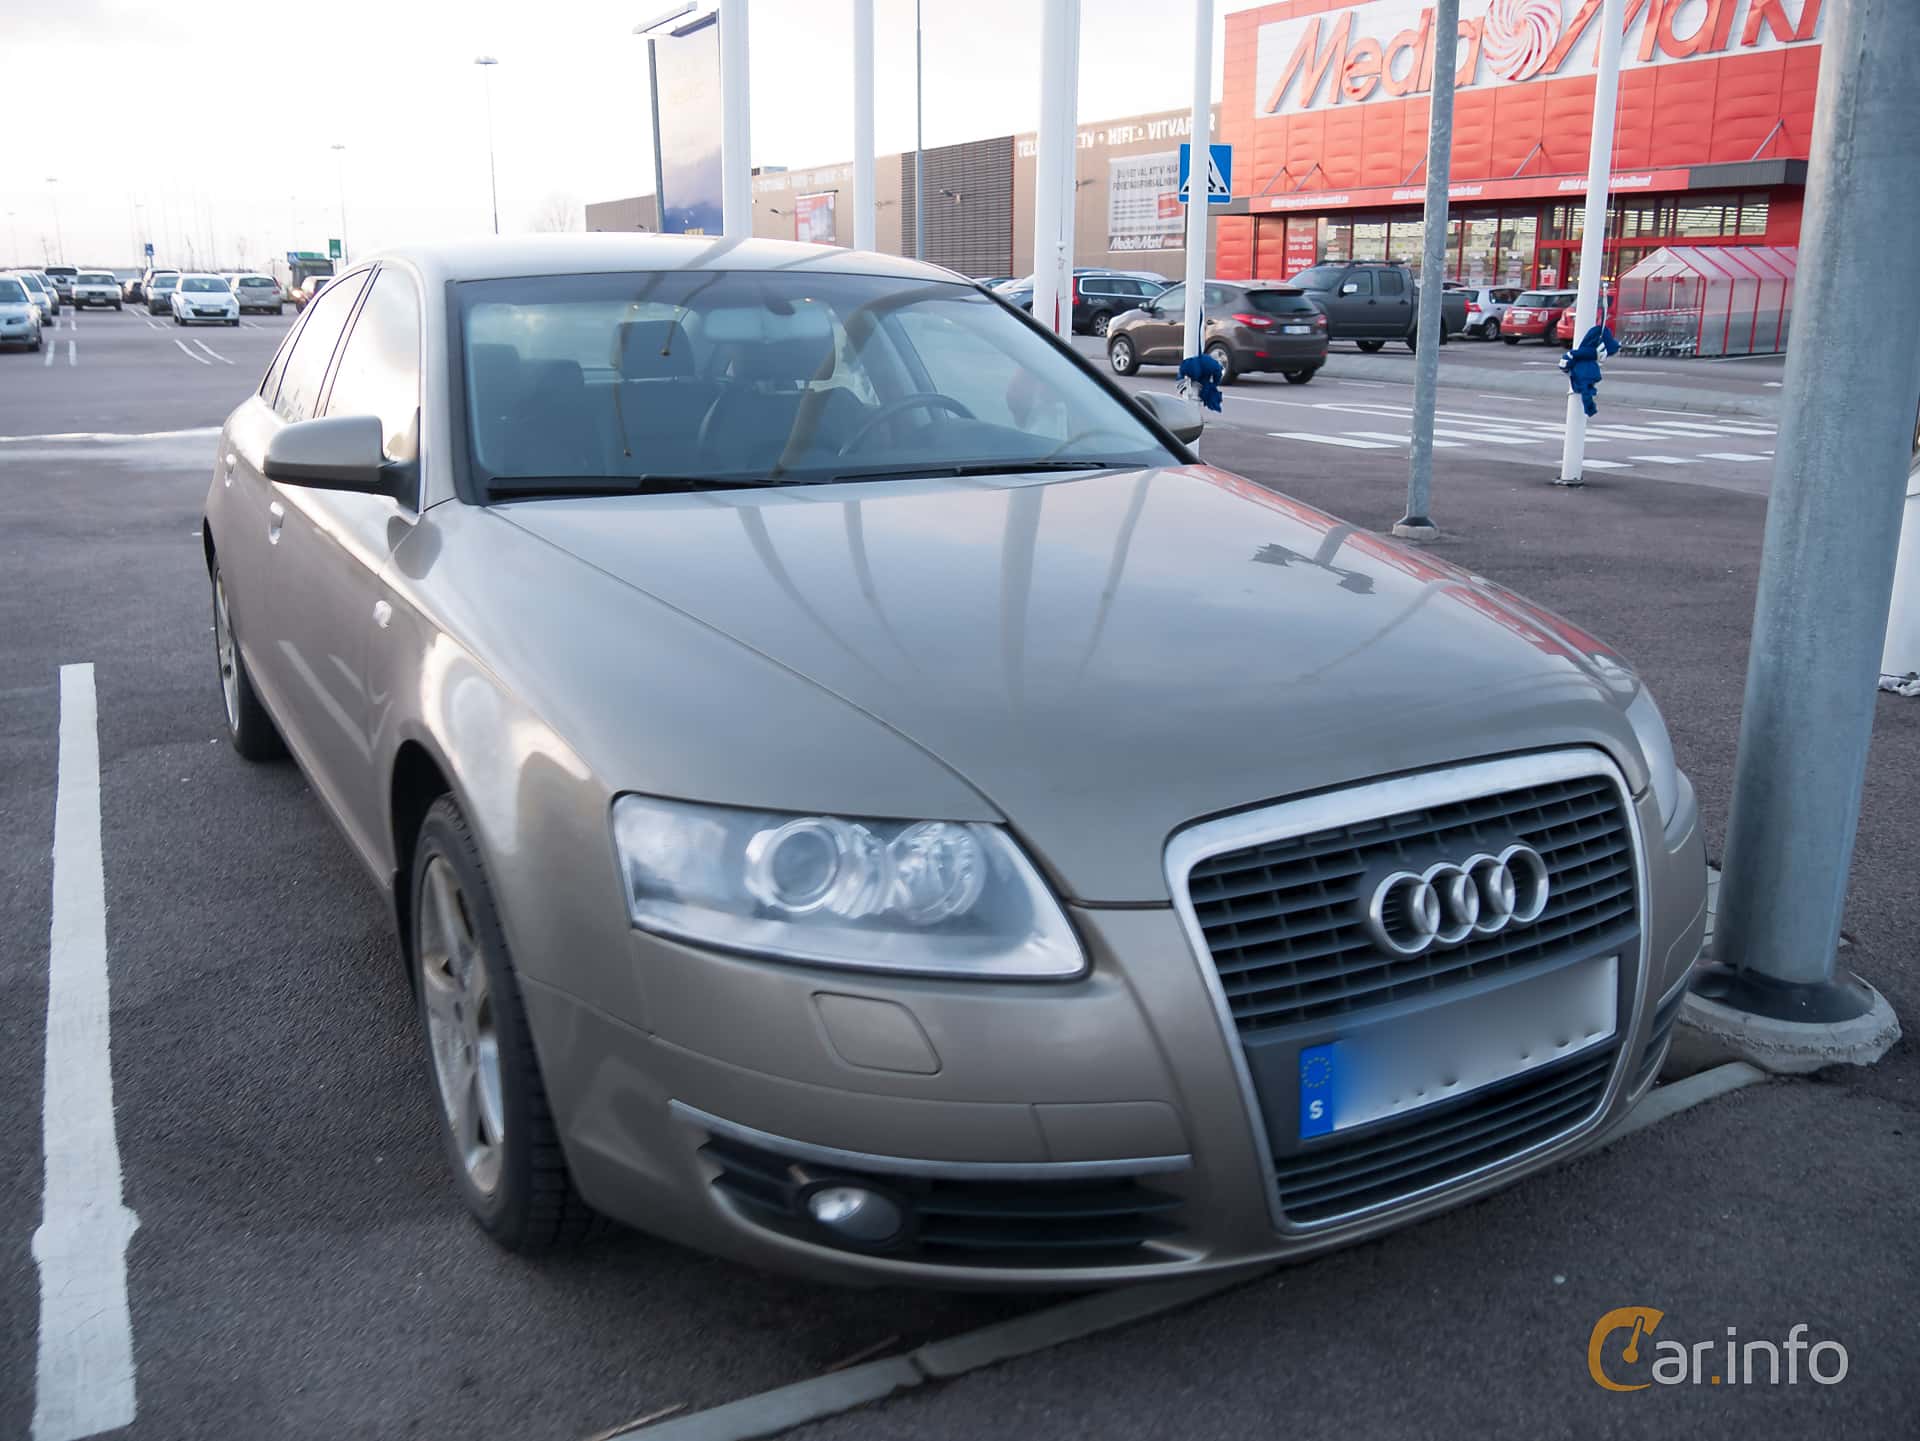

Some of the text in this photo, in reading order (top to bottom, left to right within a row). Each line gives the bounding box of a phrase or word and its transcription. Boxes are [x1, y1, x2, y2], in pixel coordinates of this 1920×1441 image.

[1108, 126, 1135, 146] HIFI
[1148, 113, 1216, 141] VITVAR
[1309, 1099, 1324, 1120] S
